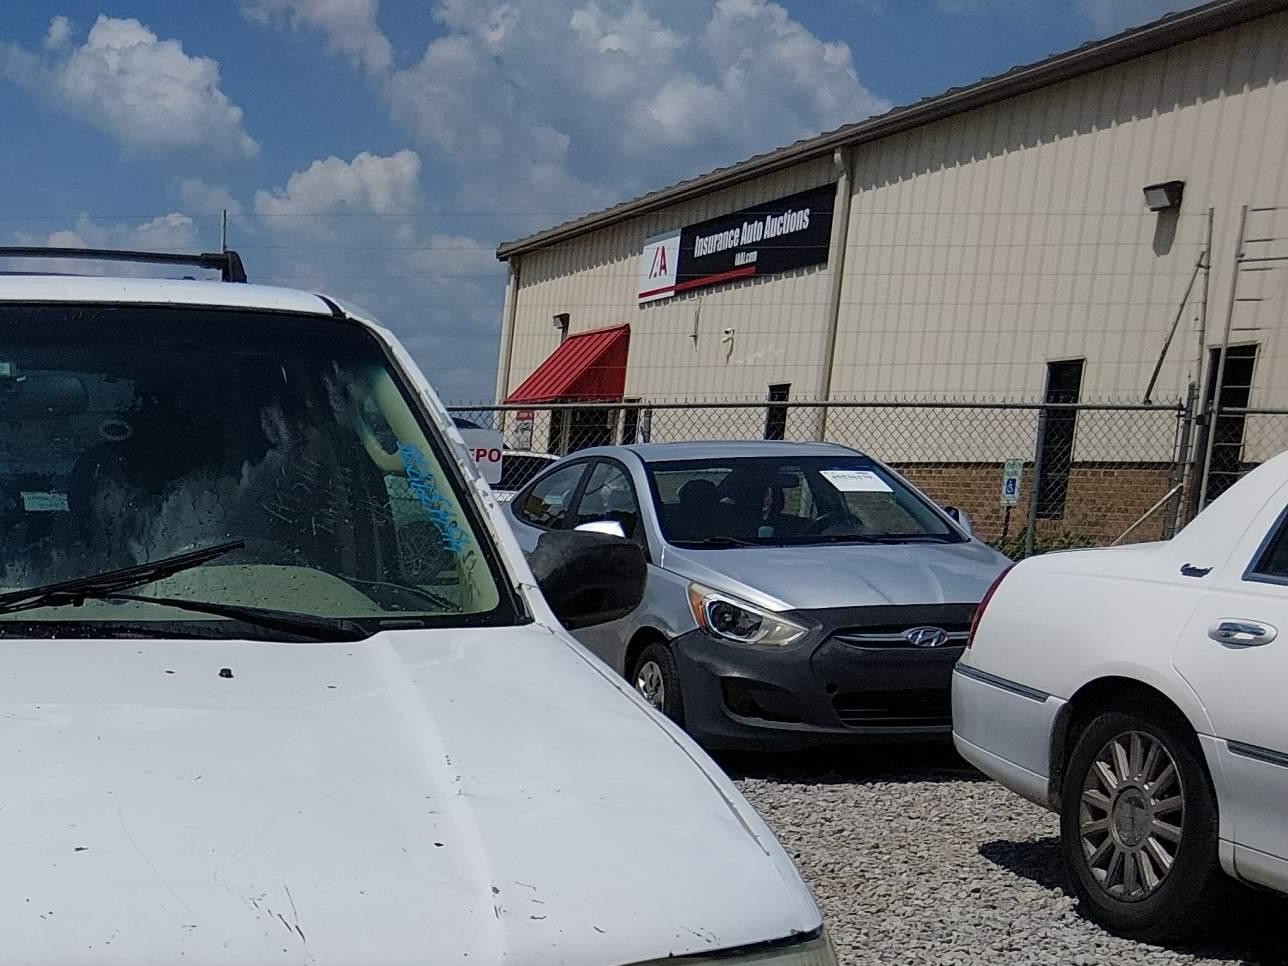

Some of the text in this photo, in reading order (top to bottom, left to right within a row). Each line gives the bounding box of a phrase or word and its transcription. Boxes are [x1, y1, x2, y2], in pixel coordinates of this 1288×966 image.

[694, 208, 810, 258] Insurance Auto Auctions
